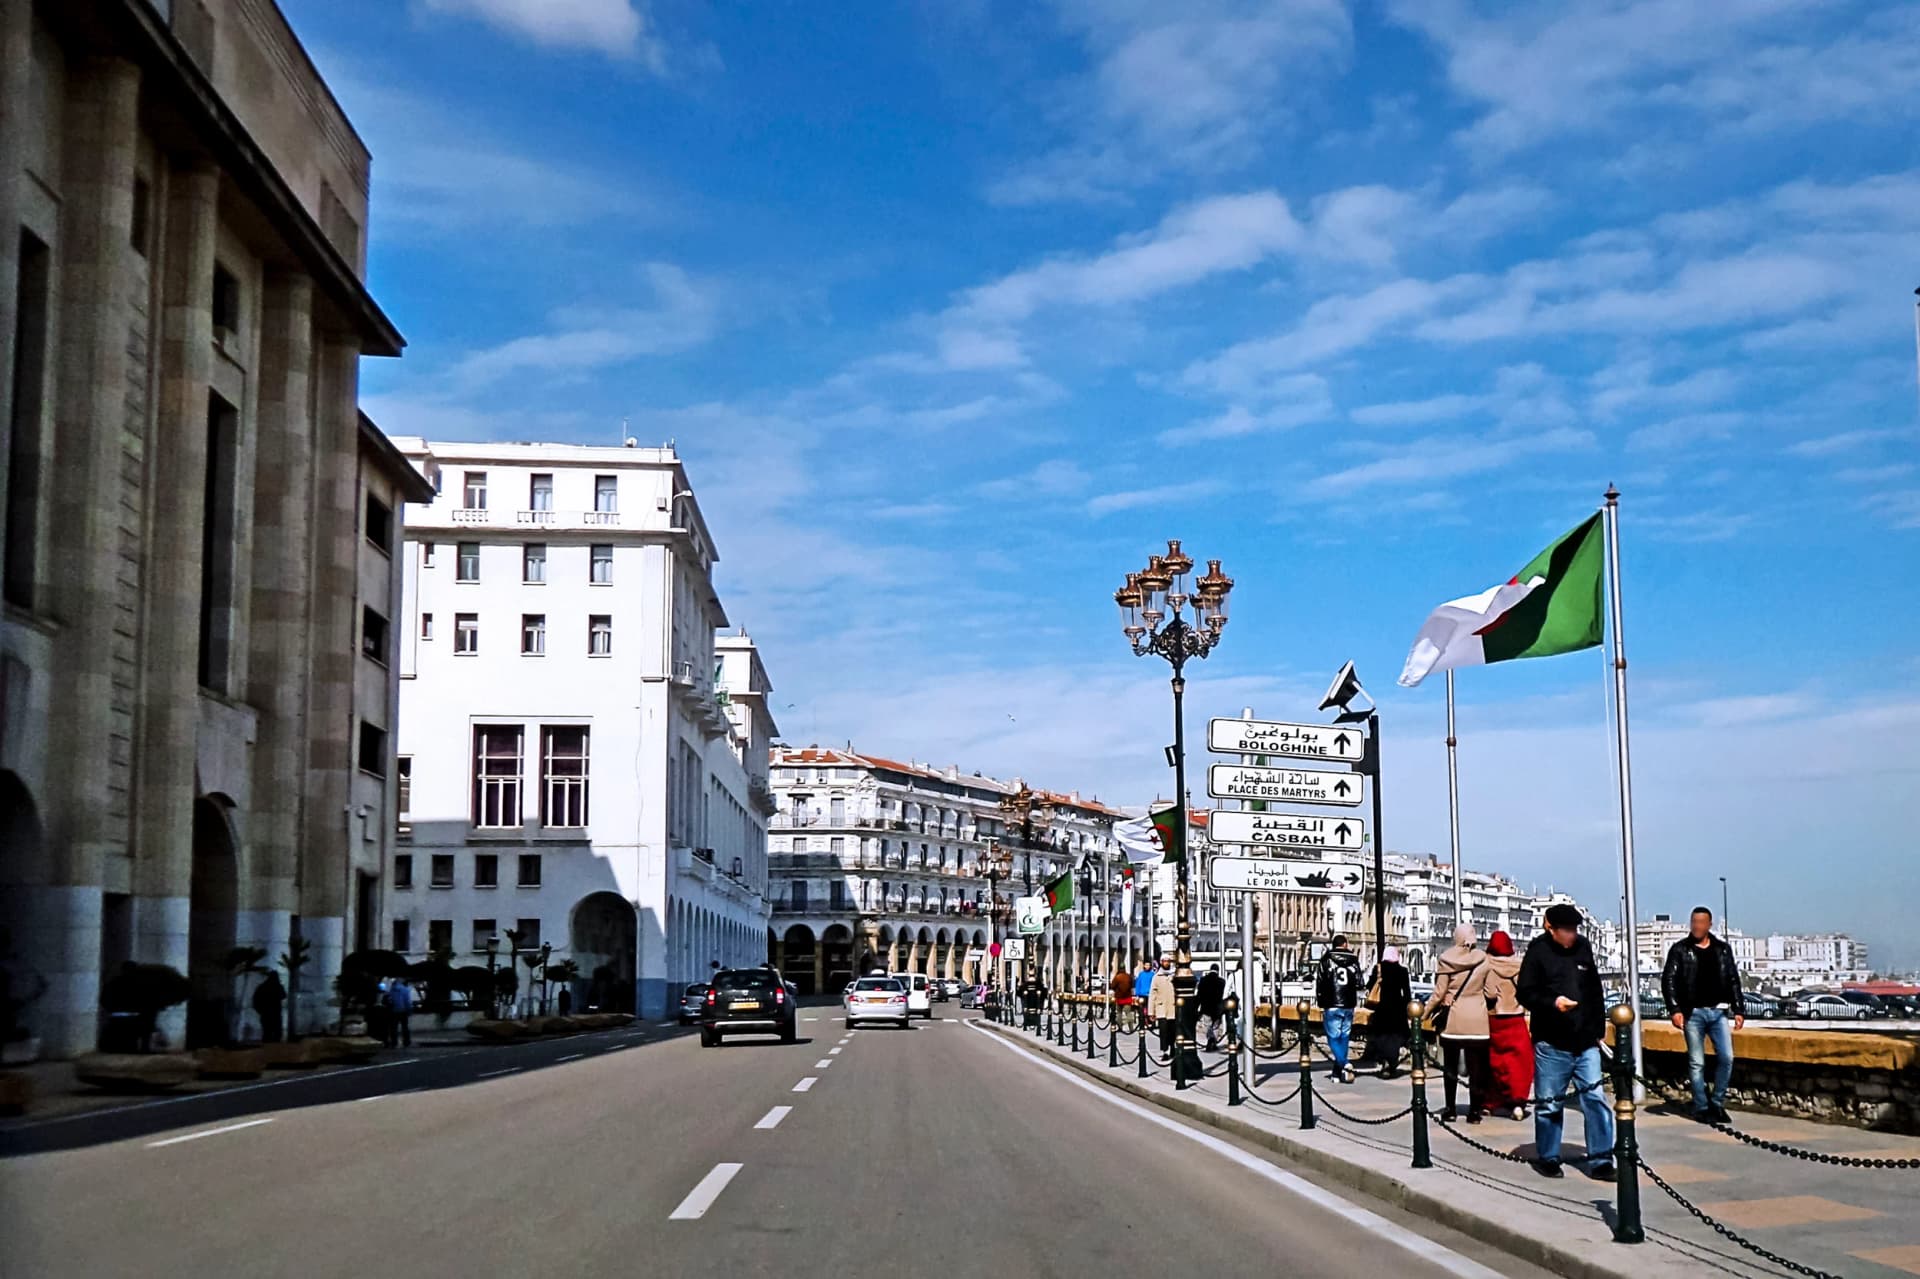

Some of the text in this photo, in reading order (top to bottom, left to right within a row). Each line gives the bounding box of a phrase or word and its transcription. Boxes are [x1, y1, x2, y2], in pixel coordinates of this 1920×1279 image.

[1239, 740, 1328, 755] BOLOGHINE
[1228, 784, 1326, 799] PLACE DES MARTYRS
[1252, 832, 1325, 845] CASBAH
[1247, 878, 1289, 887] LE PORT
